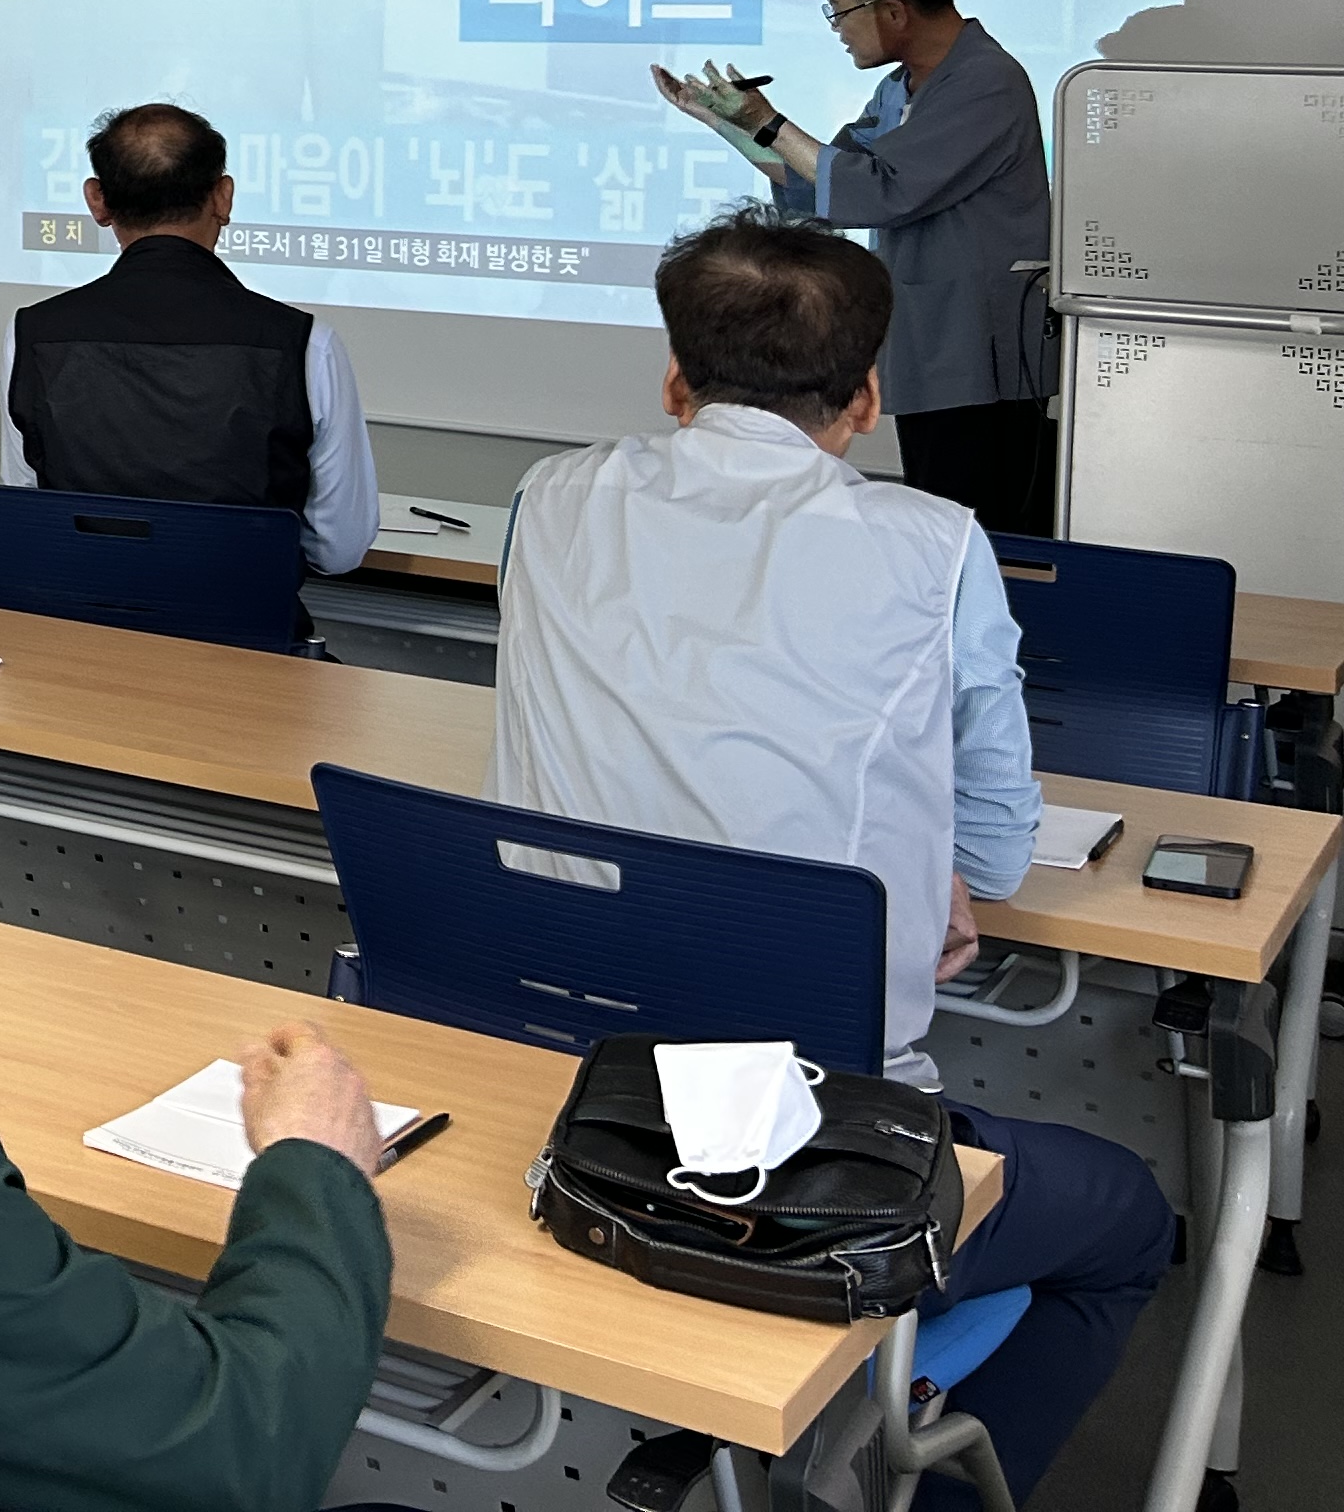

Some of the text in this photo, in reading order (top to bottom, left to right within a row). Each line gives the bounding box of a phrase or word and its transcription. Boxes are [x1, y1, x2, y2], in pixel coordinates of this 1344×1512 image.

[238, 132, 385, 218] 마음이
[297, 232, 330, 261] 1월
[335, 236, 384, 263] 31일
[389, 238, 431, 267] 대형
[436, 241, 480, 269] 화재
[485, 242, 553, 275] 발생한
